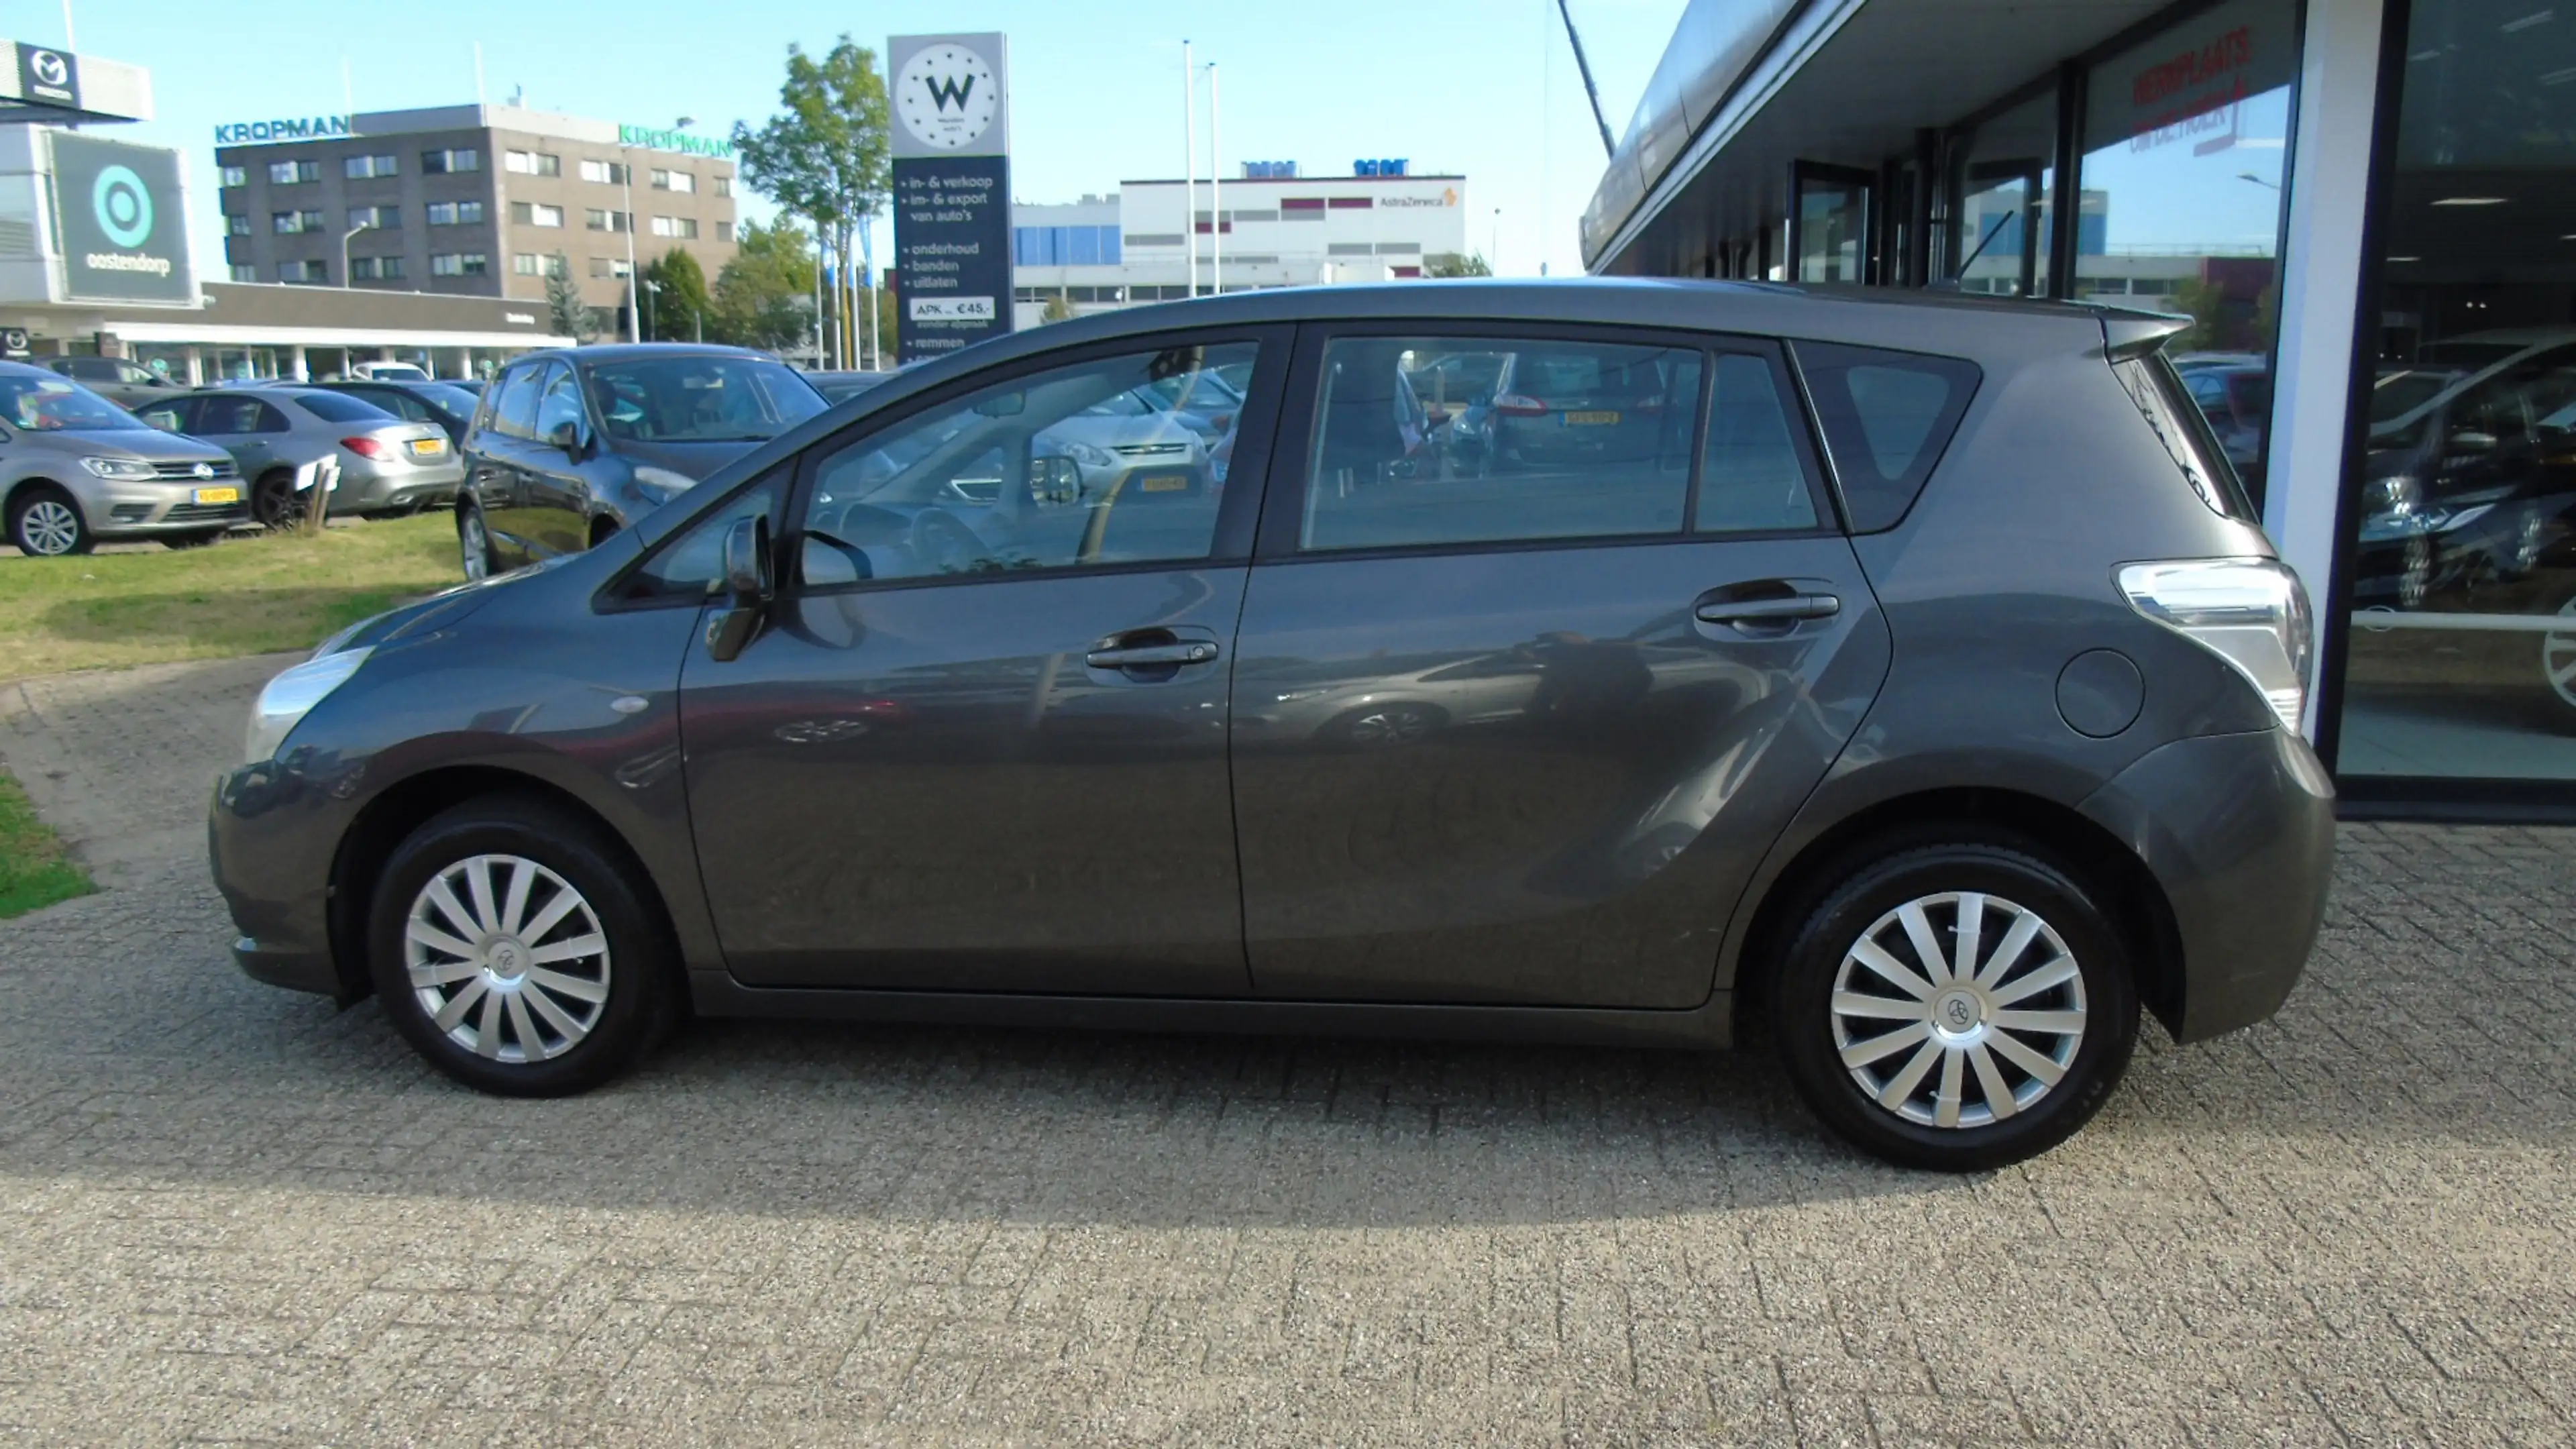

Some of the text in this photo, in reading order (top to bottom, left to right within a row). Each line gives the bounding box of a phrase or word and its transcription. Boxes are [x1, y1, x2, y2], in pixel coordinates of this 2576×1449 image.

[925, 73, 975, 113] W
[215, 115, 351, 143] KROPMAN
[619, 123, 734, 158] KROPMAN
[943, 174, 994, 191] verkoop
[947, 193, 988, 207] export
[1381, 197, 1443, 207] AstraZeneca
[910, 209, 973, 222] van auto's
[912, 242, 979, 255] onderhoud
[87, 252, 170, 277] oostendorp
[912, 260, 960, 272] banden
[913, 276, 958, 289] uitlaten
[916, 304, 943, 315] APK
[915, 338, 965, 349] remmen
